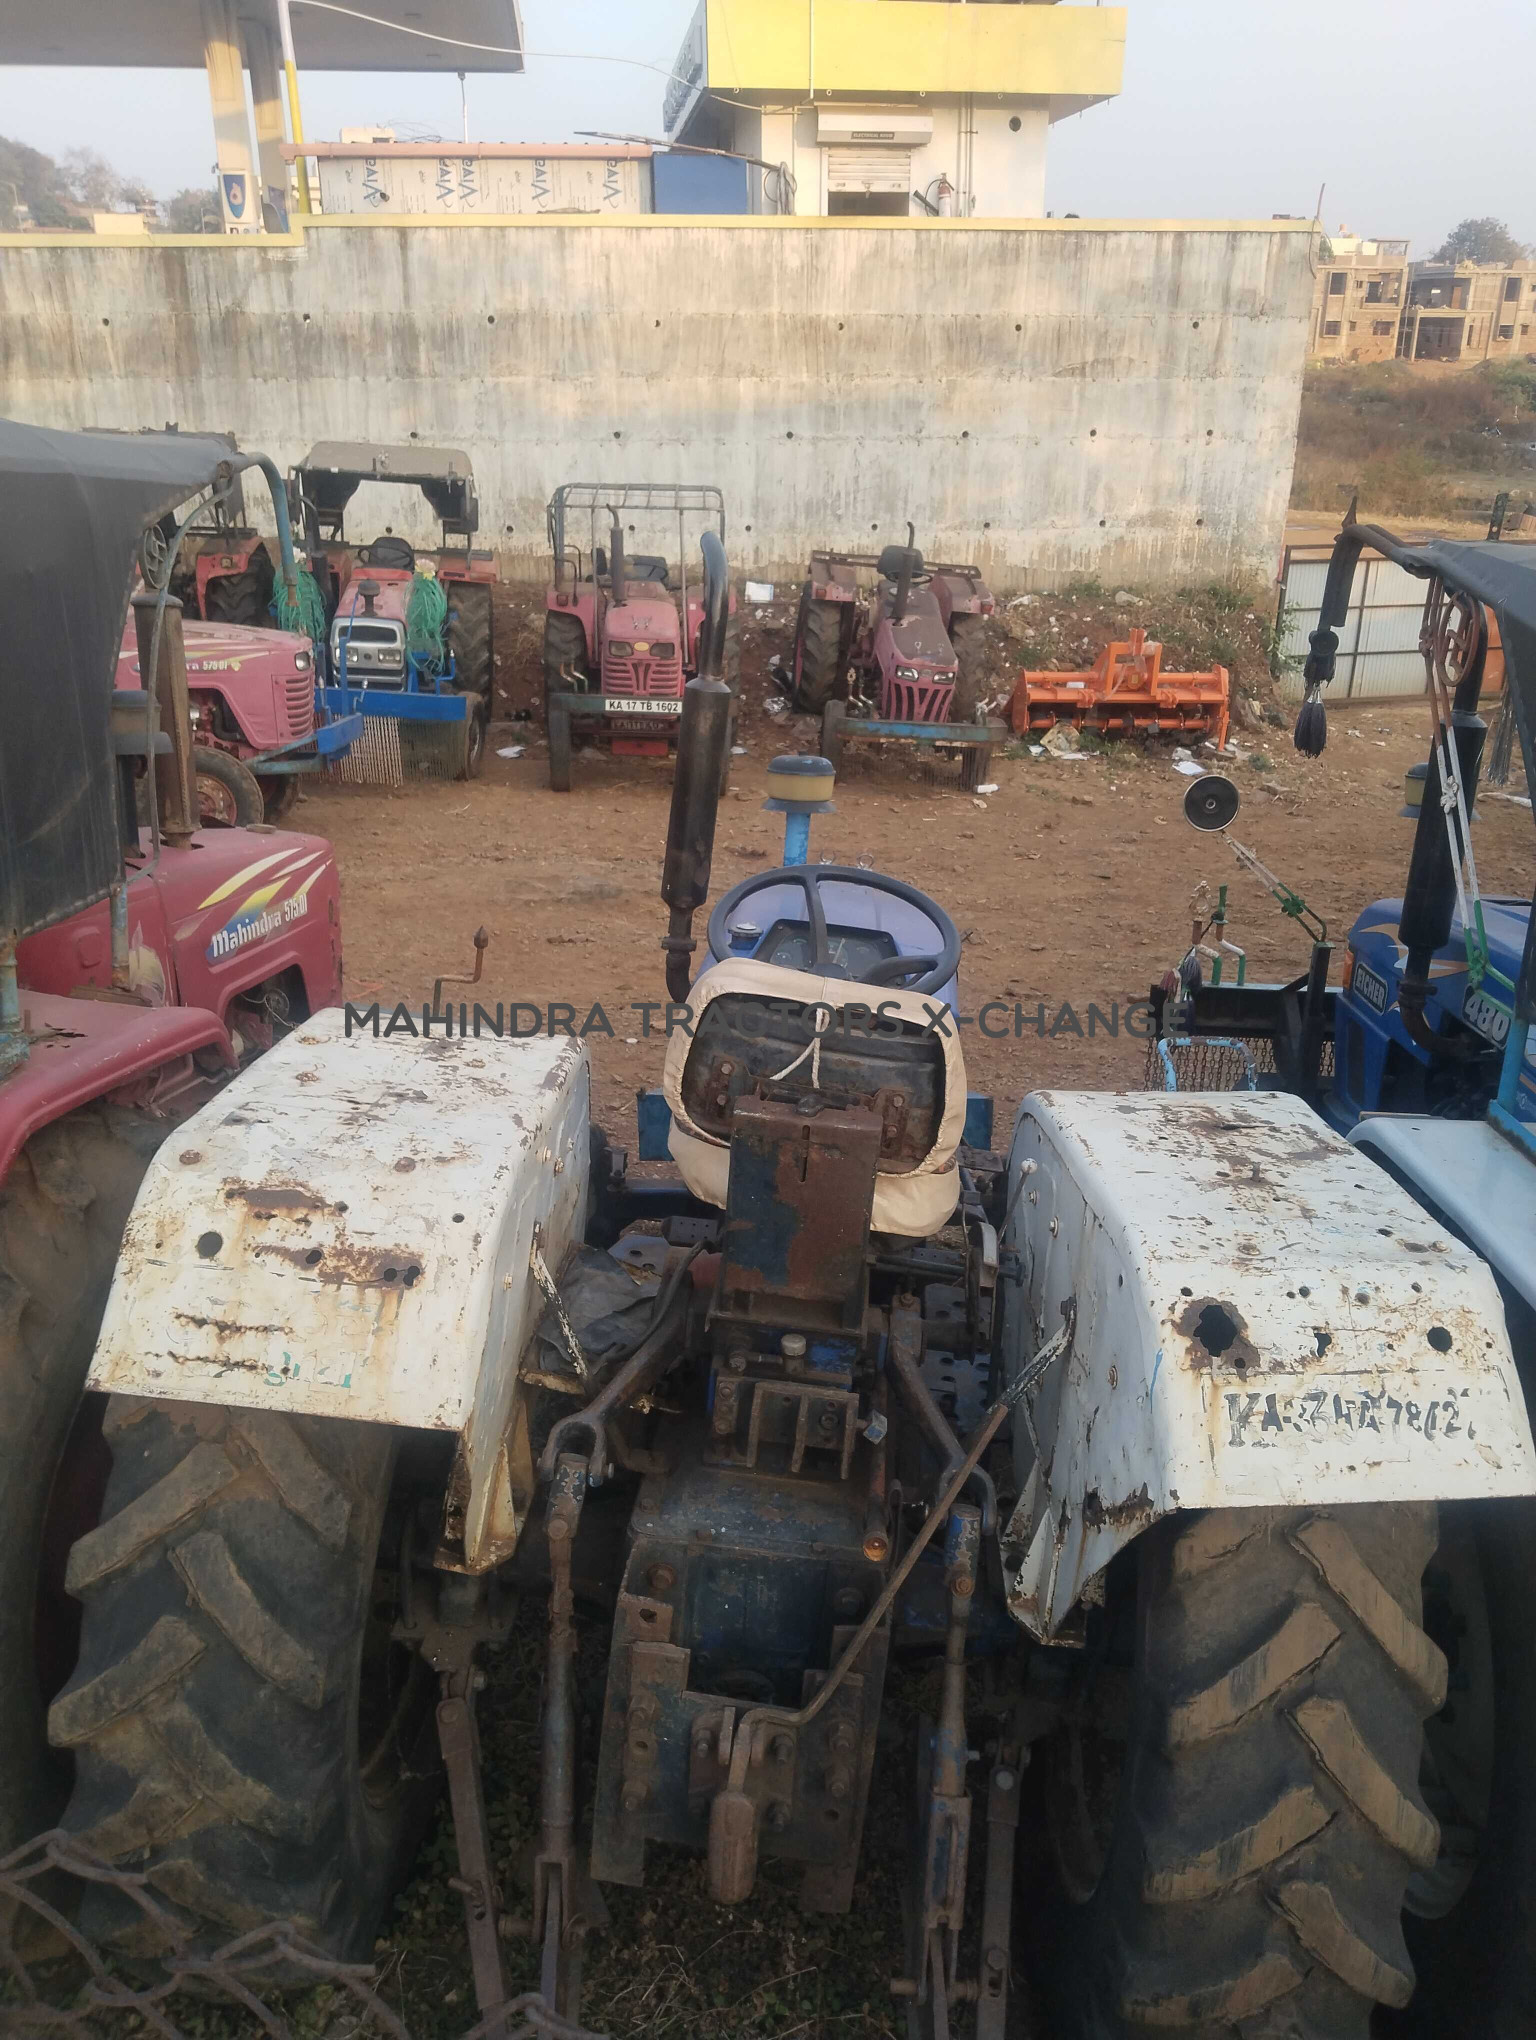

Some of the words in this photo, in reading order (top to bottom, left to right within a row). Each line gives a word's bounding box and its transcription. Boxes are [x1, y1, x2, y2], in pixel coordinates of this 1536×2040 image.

[609, 701, 623, 710] KA
[626, 701, 637, 710] 17
[639, 701, 653, 711] TB
[655, 702, 679, 712] 1602
[212, 911, 282, 958] Mahindra
[1356, 967, 1385, 1008] EICHER
[1465, 994, 1508, 1041] 480
